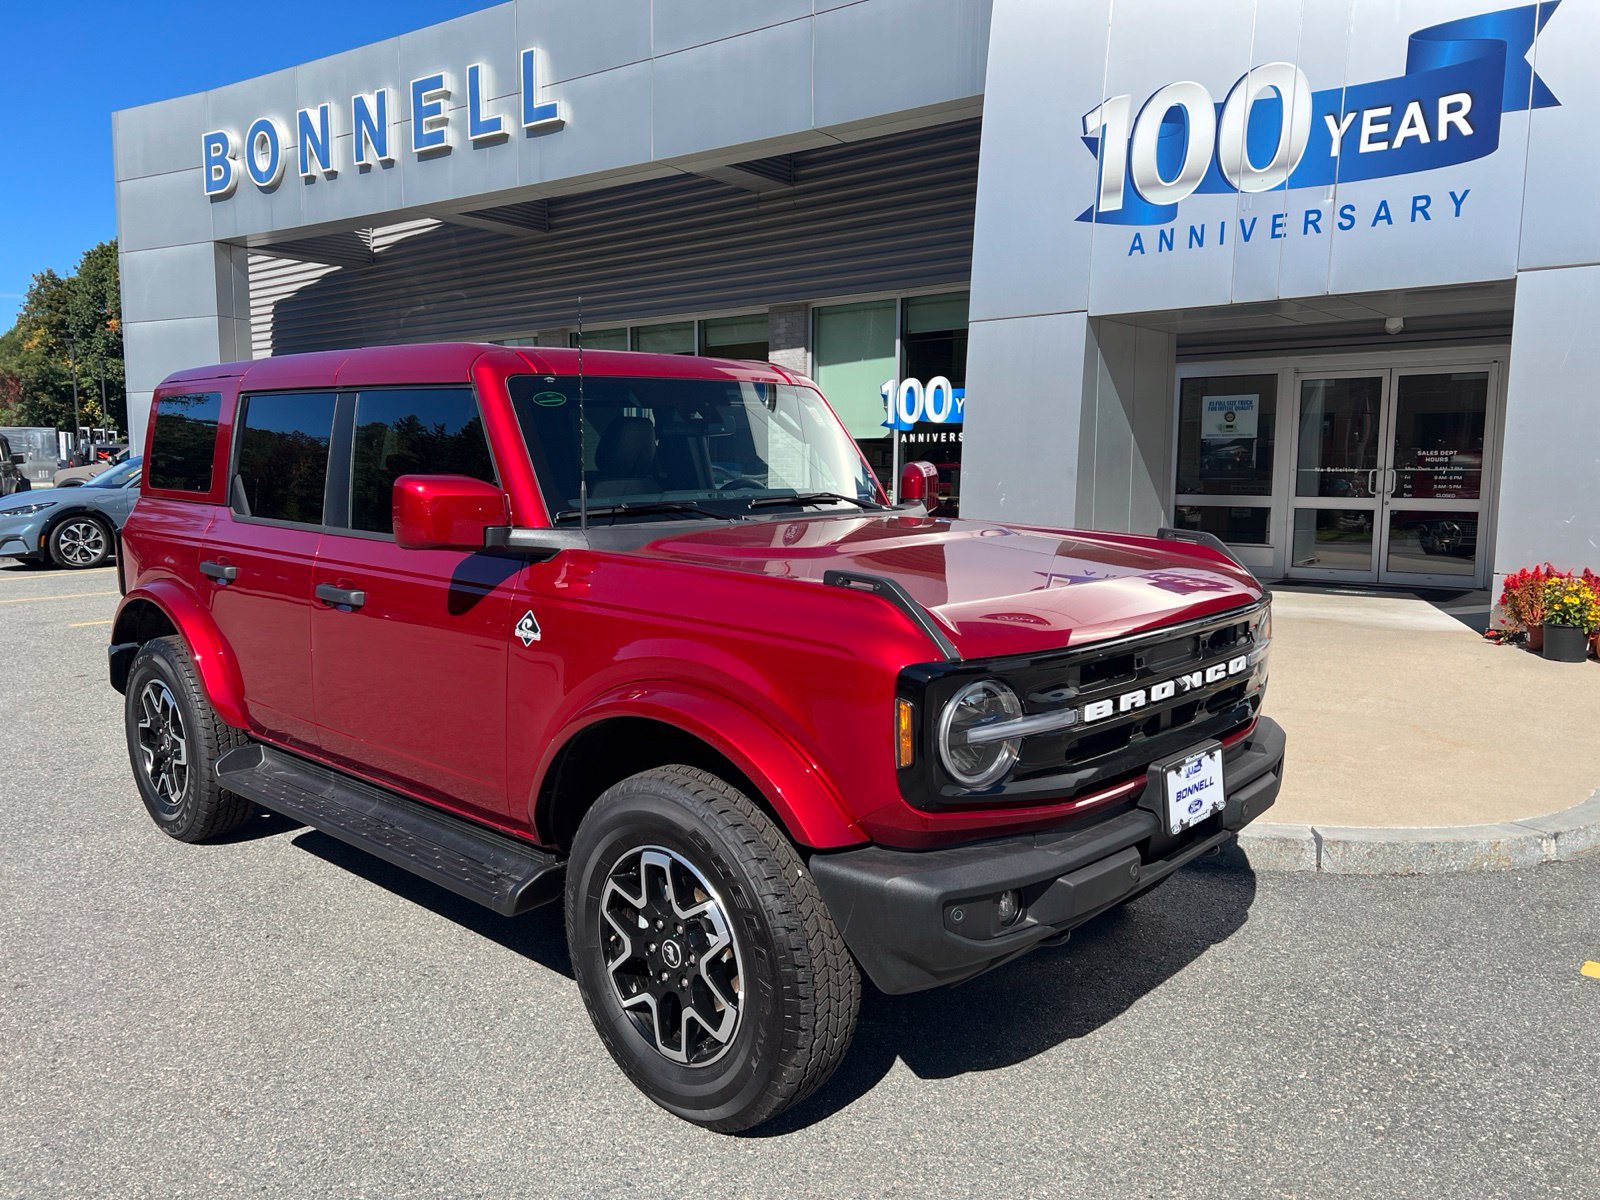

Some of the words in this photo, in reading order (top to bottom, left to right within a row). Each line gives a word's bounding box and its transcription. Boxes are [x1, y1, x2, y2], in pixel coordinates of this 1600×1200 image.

[202, 47, 566, 197] BONNELL
[1082, 61, 1313, 213] 100
[1323, 92, 1474, 158] YEAR
[1128, 189, 1472, 257] ANNIVERSARY
[881, 375, 953, 424] 100
[1084, 654, 1247, 723] BRONCO
[1175, 776, 1215, 803] BONNELL
